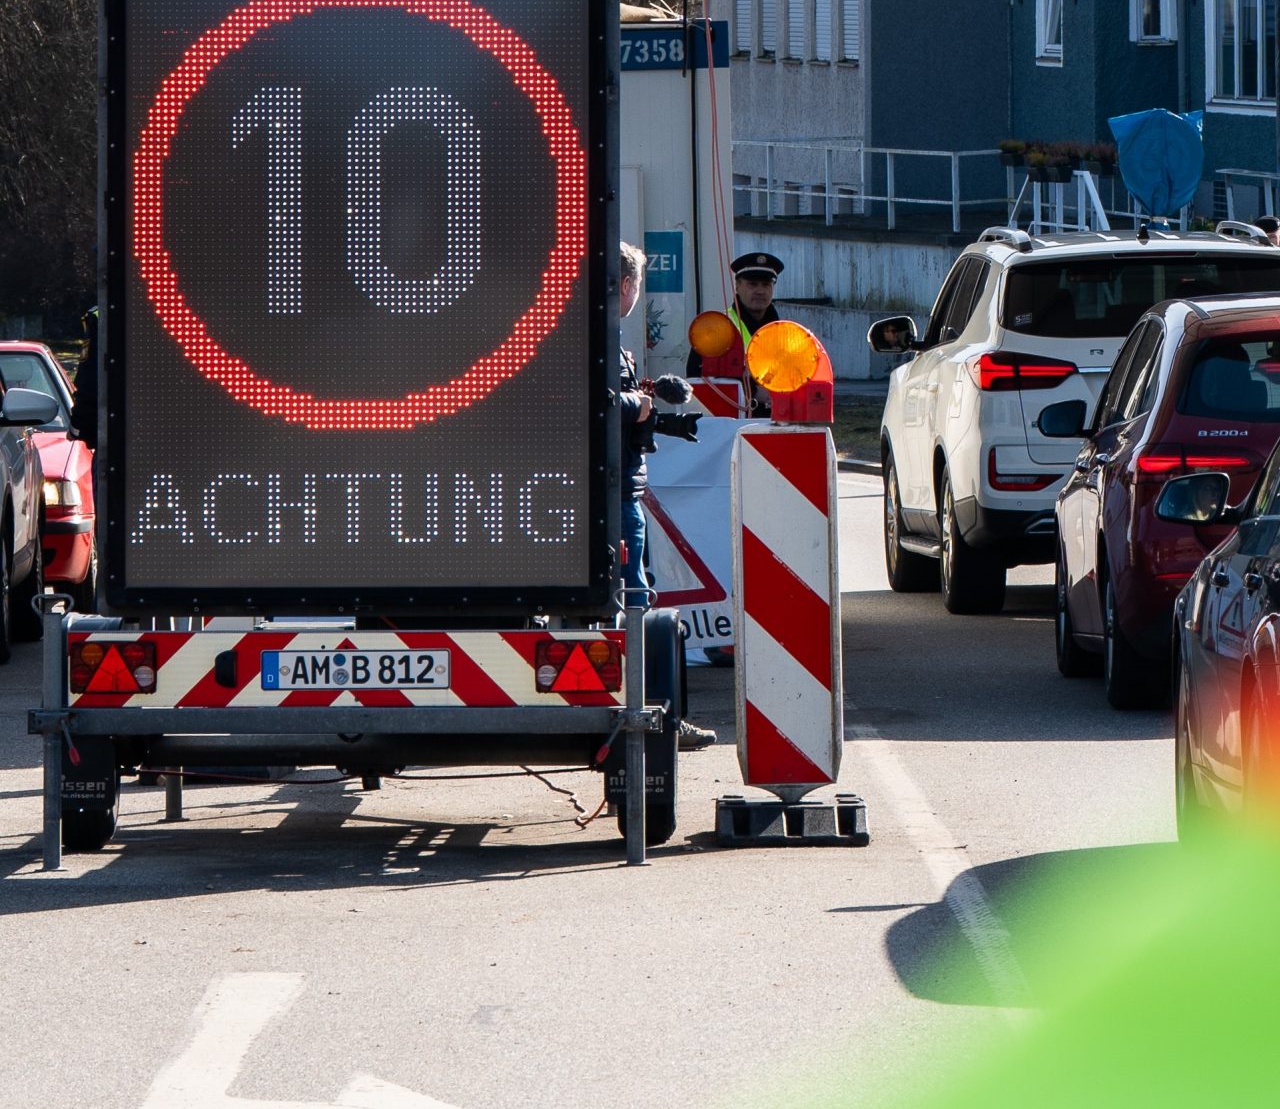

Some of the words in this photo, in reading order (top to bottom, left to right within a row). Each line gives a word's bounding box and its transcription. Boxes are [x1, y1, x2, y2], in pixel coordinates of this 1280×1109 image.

[232, 86, 482, 313] 10
[131, 472, 576, 544] ACHTUNG
[267, 674, 274, 683] D
[291, 655, 330, 685] AM
[352, 655, 371, 684] B
[378, 655, 434, 684] 812
